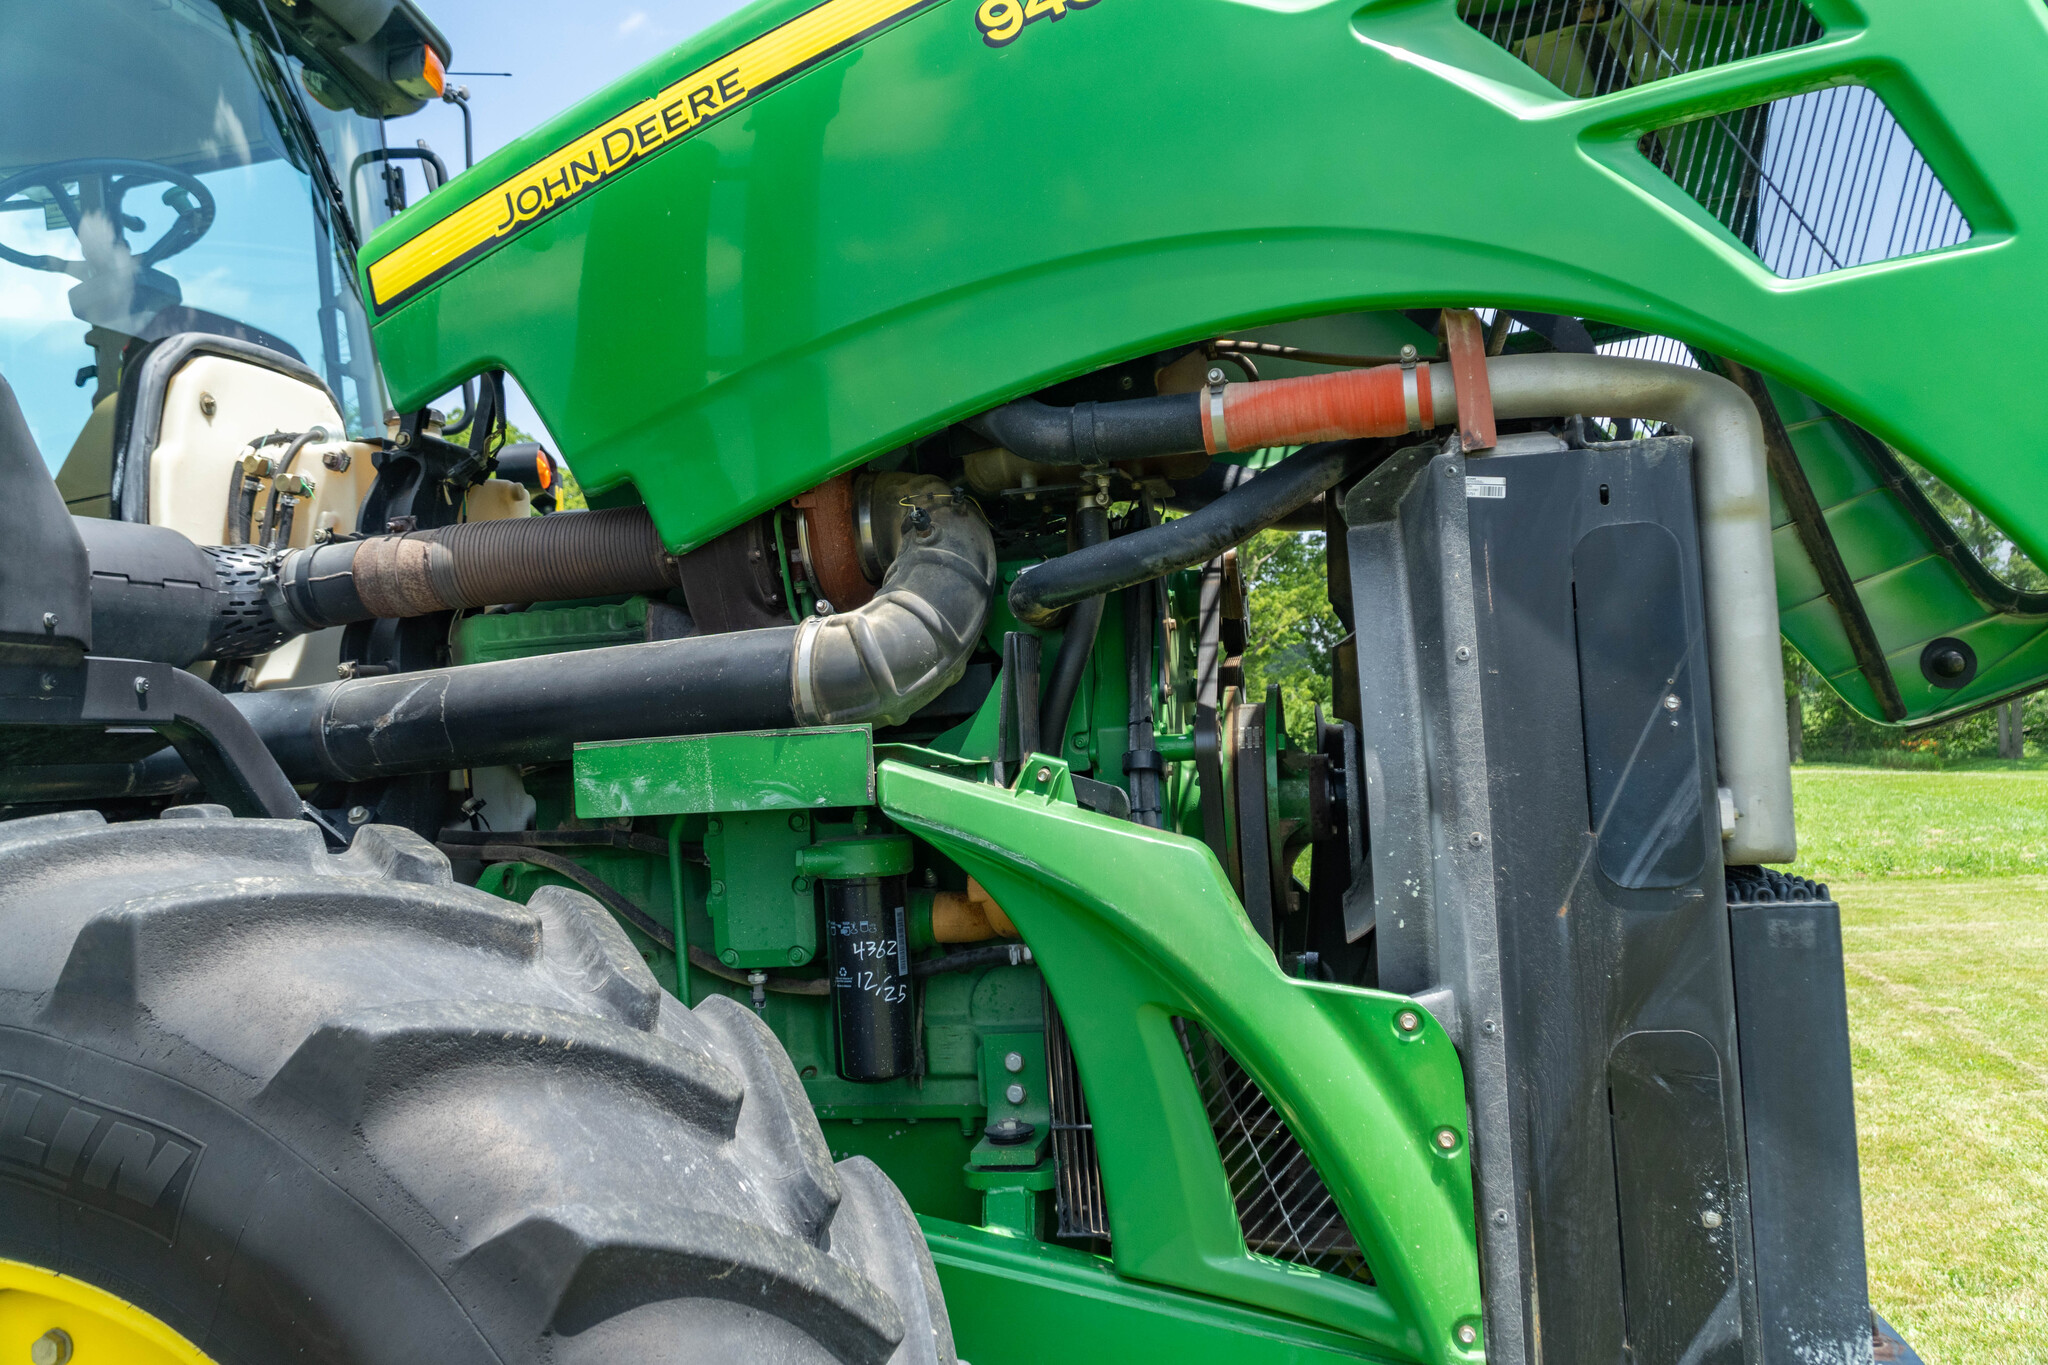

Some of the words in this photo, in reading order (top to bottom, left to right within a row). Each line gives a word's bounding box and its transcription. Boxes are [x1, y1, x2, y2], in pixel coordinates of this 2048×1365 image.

[498, 150, 599, 231] JOHN
[602, 67, 746, 167] DEERE
[852, 939, 898, 961] 4362
[0, 1083, 192, 1208] LIN
